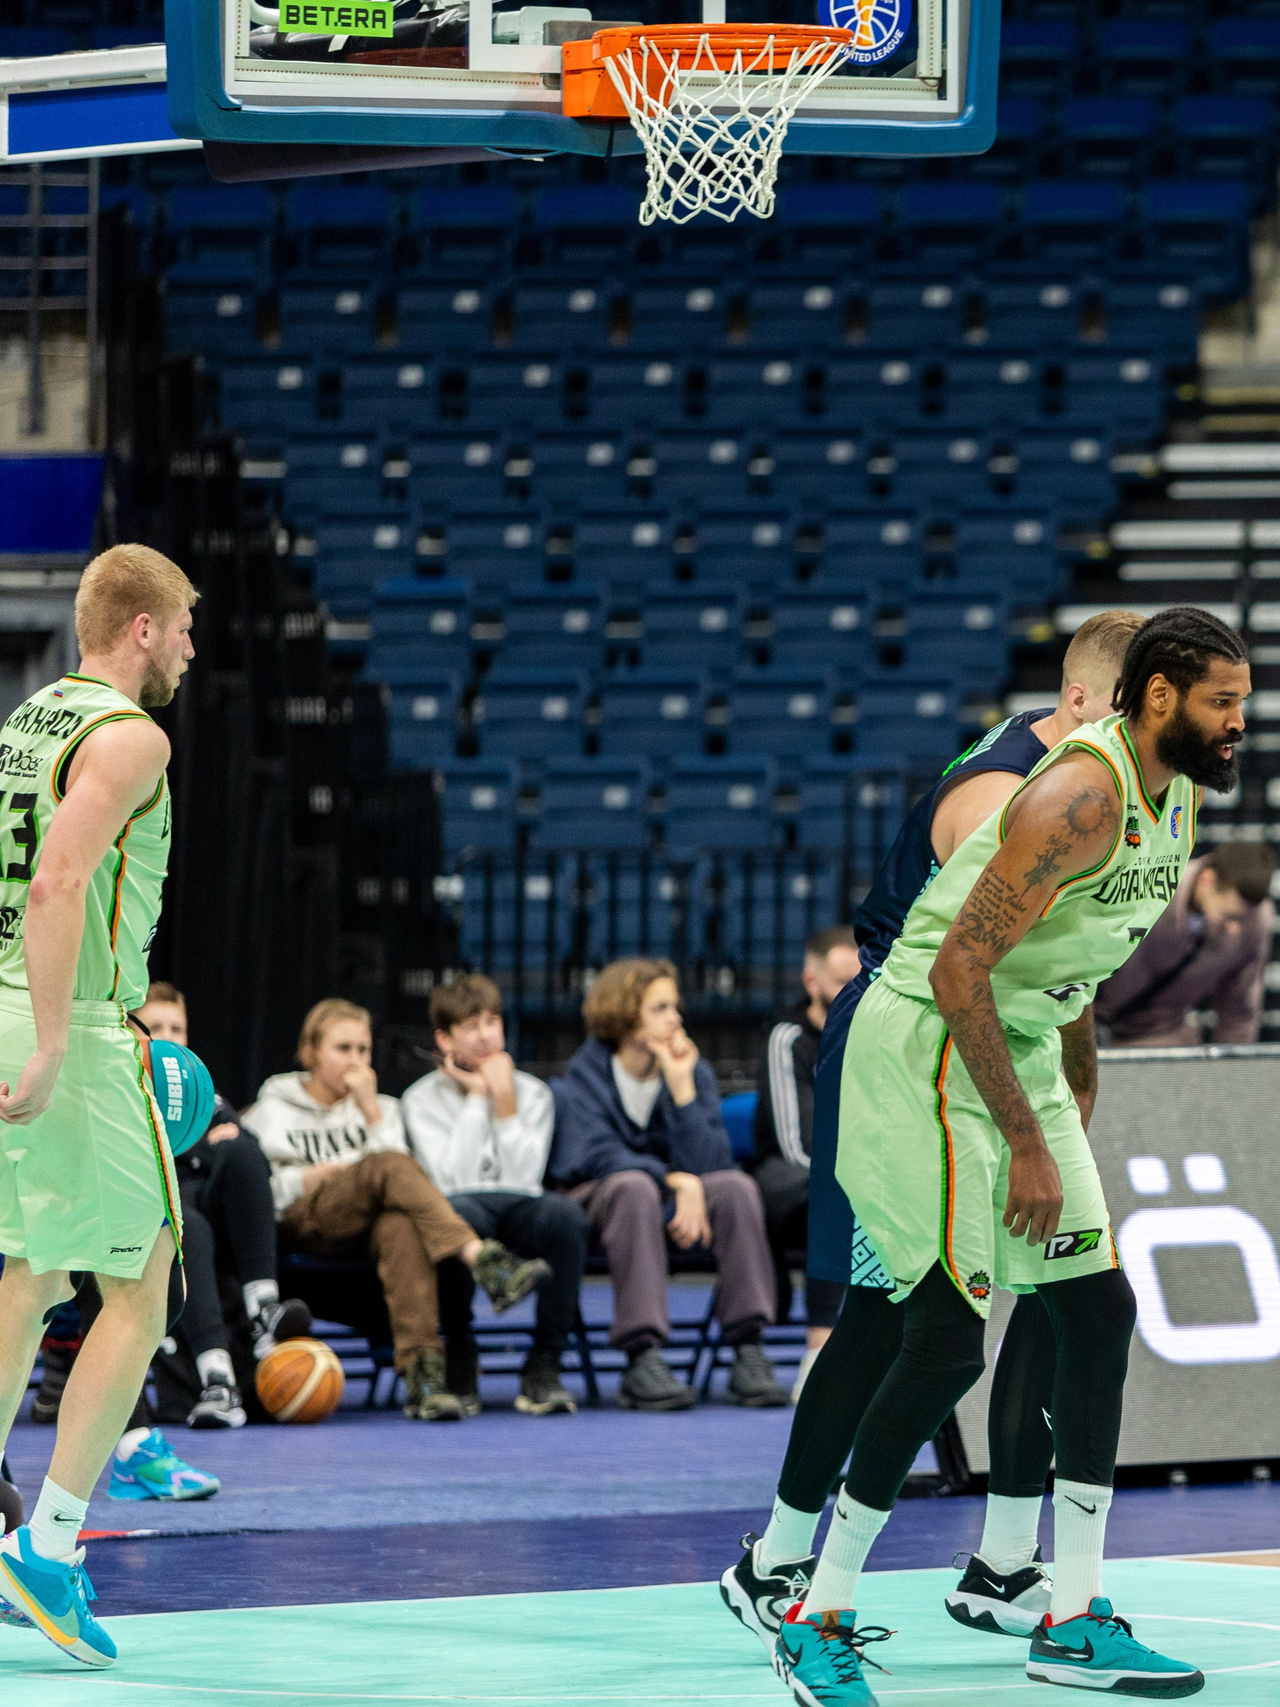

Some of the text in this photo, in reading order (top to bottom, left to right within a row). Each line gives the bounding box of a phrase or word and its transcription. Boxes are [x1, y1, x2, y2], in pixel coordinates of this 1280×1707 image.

[872, 28, 904, 61] LEAGUE
[0, 789, 40, 883] 3
[161, 1056, 184, 1122] SIBUR
